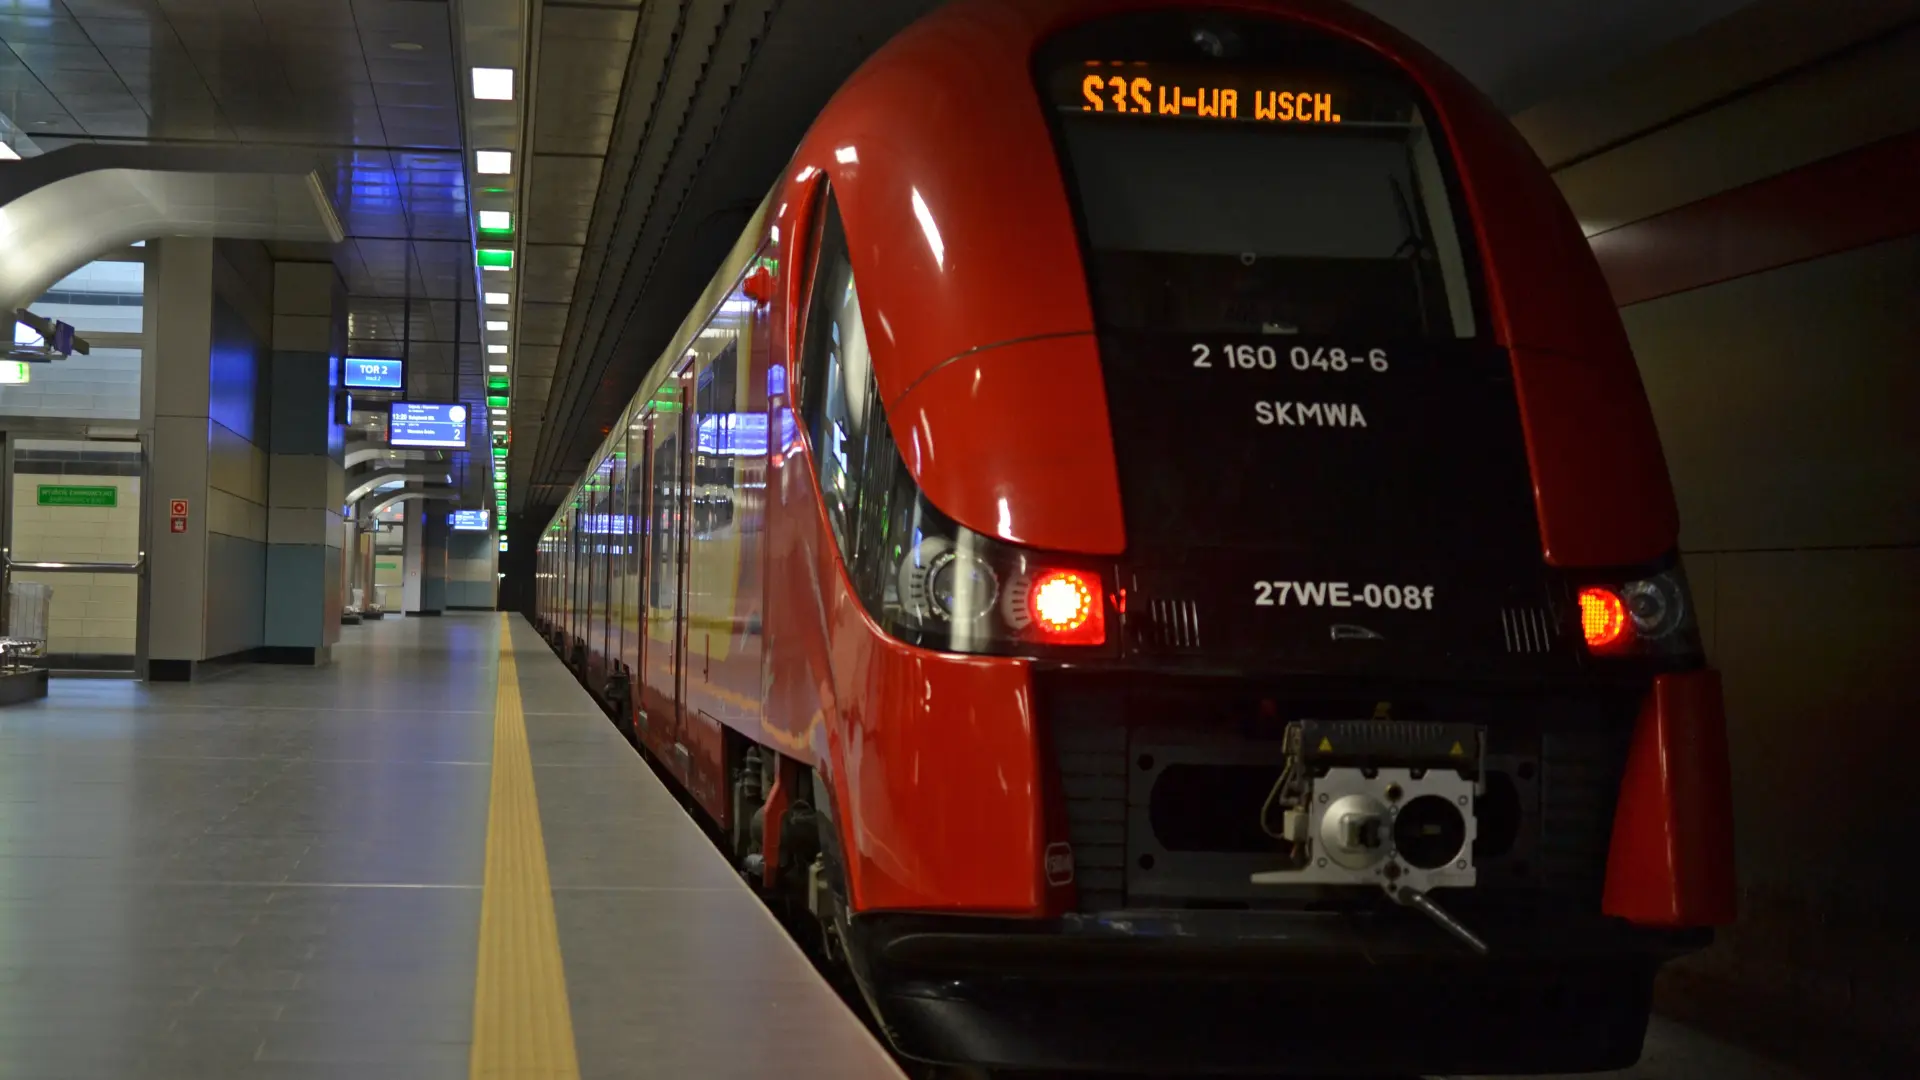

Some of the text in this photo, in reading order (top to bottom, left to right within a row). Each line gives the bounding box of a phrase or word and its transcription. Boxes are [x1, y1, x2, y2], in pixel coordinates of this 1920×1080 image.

[1158, 85, 1238, 119] W-WA
[1254, 90, 1341, 123] WSCH.
[360, 364, 388, 375] TOR 2
[1191, 343, 1388, 372] 2 160 048-6
[1255, 400, 1367, 427] SKMWA
[453, 428, 461, 440] 2
[1253, 580, 1434, 610] 27WE-008f
